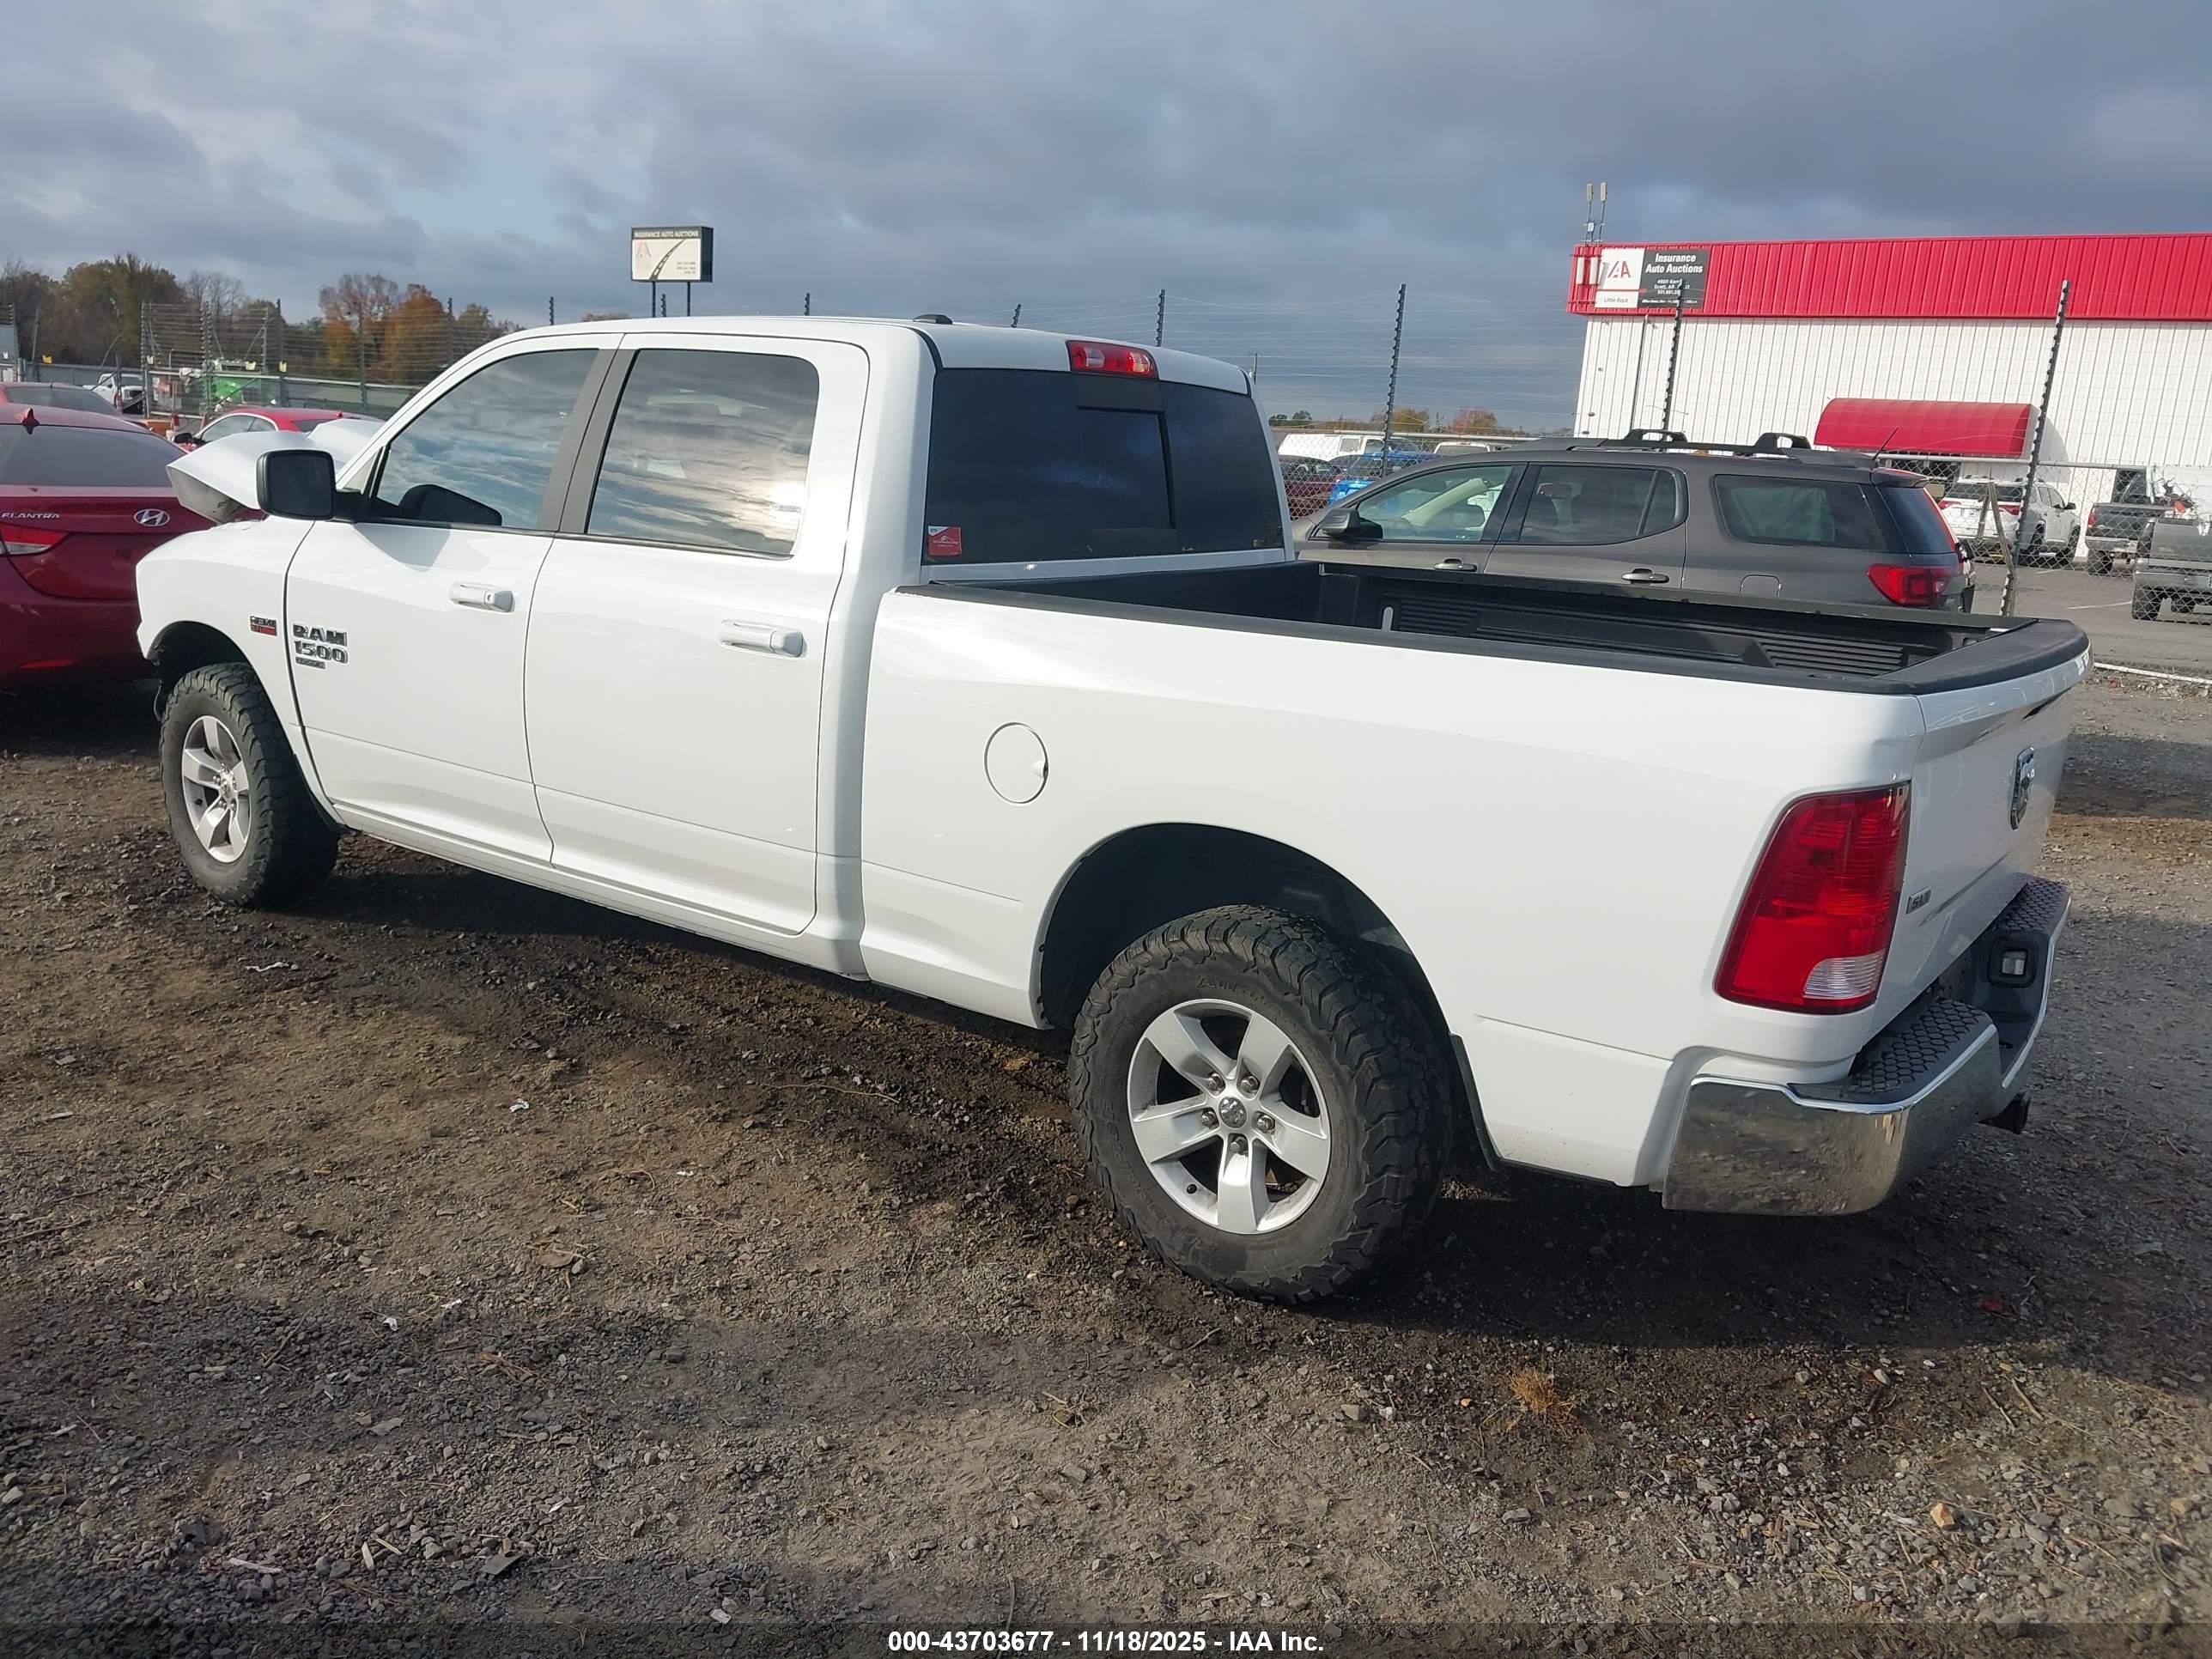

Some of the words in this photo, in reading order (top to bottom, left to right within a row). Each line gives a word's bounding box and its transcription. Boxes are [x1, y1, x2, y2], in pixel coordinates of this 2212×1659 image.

[1656, 252, 1697, 263] Insurance
[1645, 264, 1665, 273] Auto
[1666, 264, 1704, 273] Auctions
[293, 624, 347, 647] RAM
[294, 640, 348, 664] 1500
